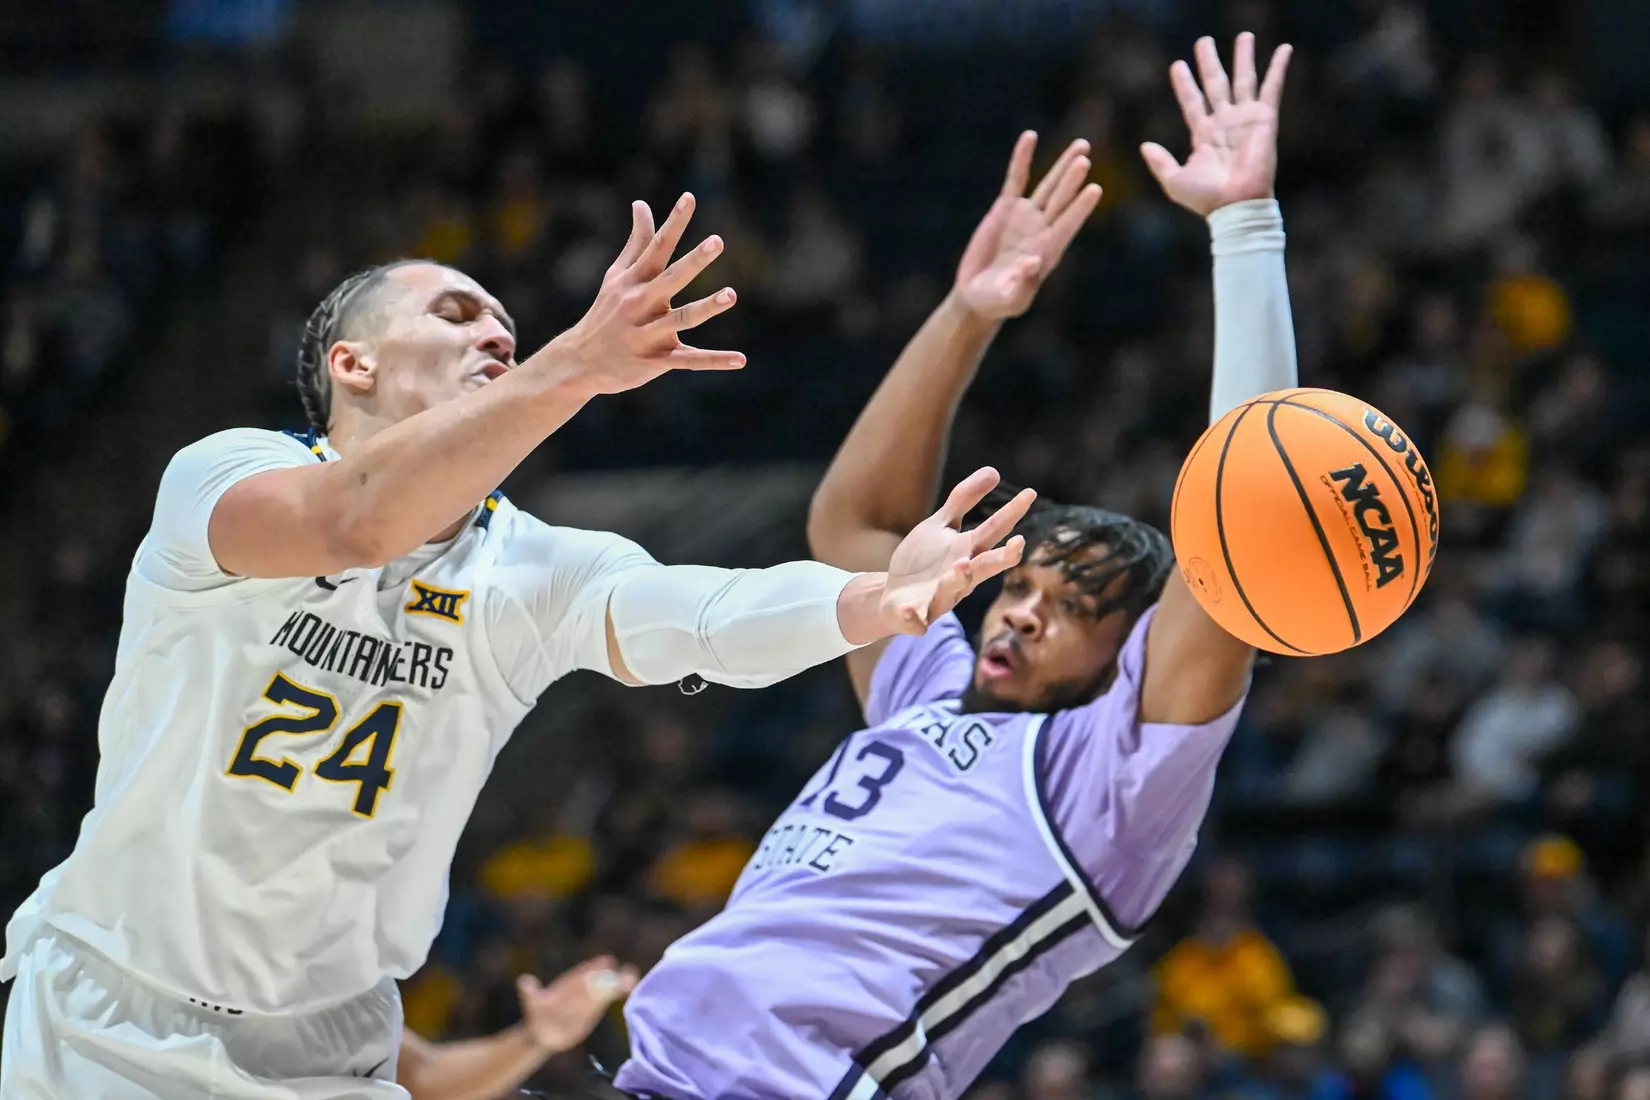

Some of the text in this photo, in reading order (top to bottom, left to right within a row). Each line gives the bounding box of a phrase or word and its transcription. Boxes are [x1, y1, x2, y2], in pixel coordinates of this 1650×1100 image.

[1320, 475, 1373, 593] OFFICIAL GAME BALL
[1328, 462, 1405, 589] NCAA
[407, 583, 465, 622] XII
[225, 669, 403, 820] 24
